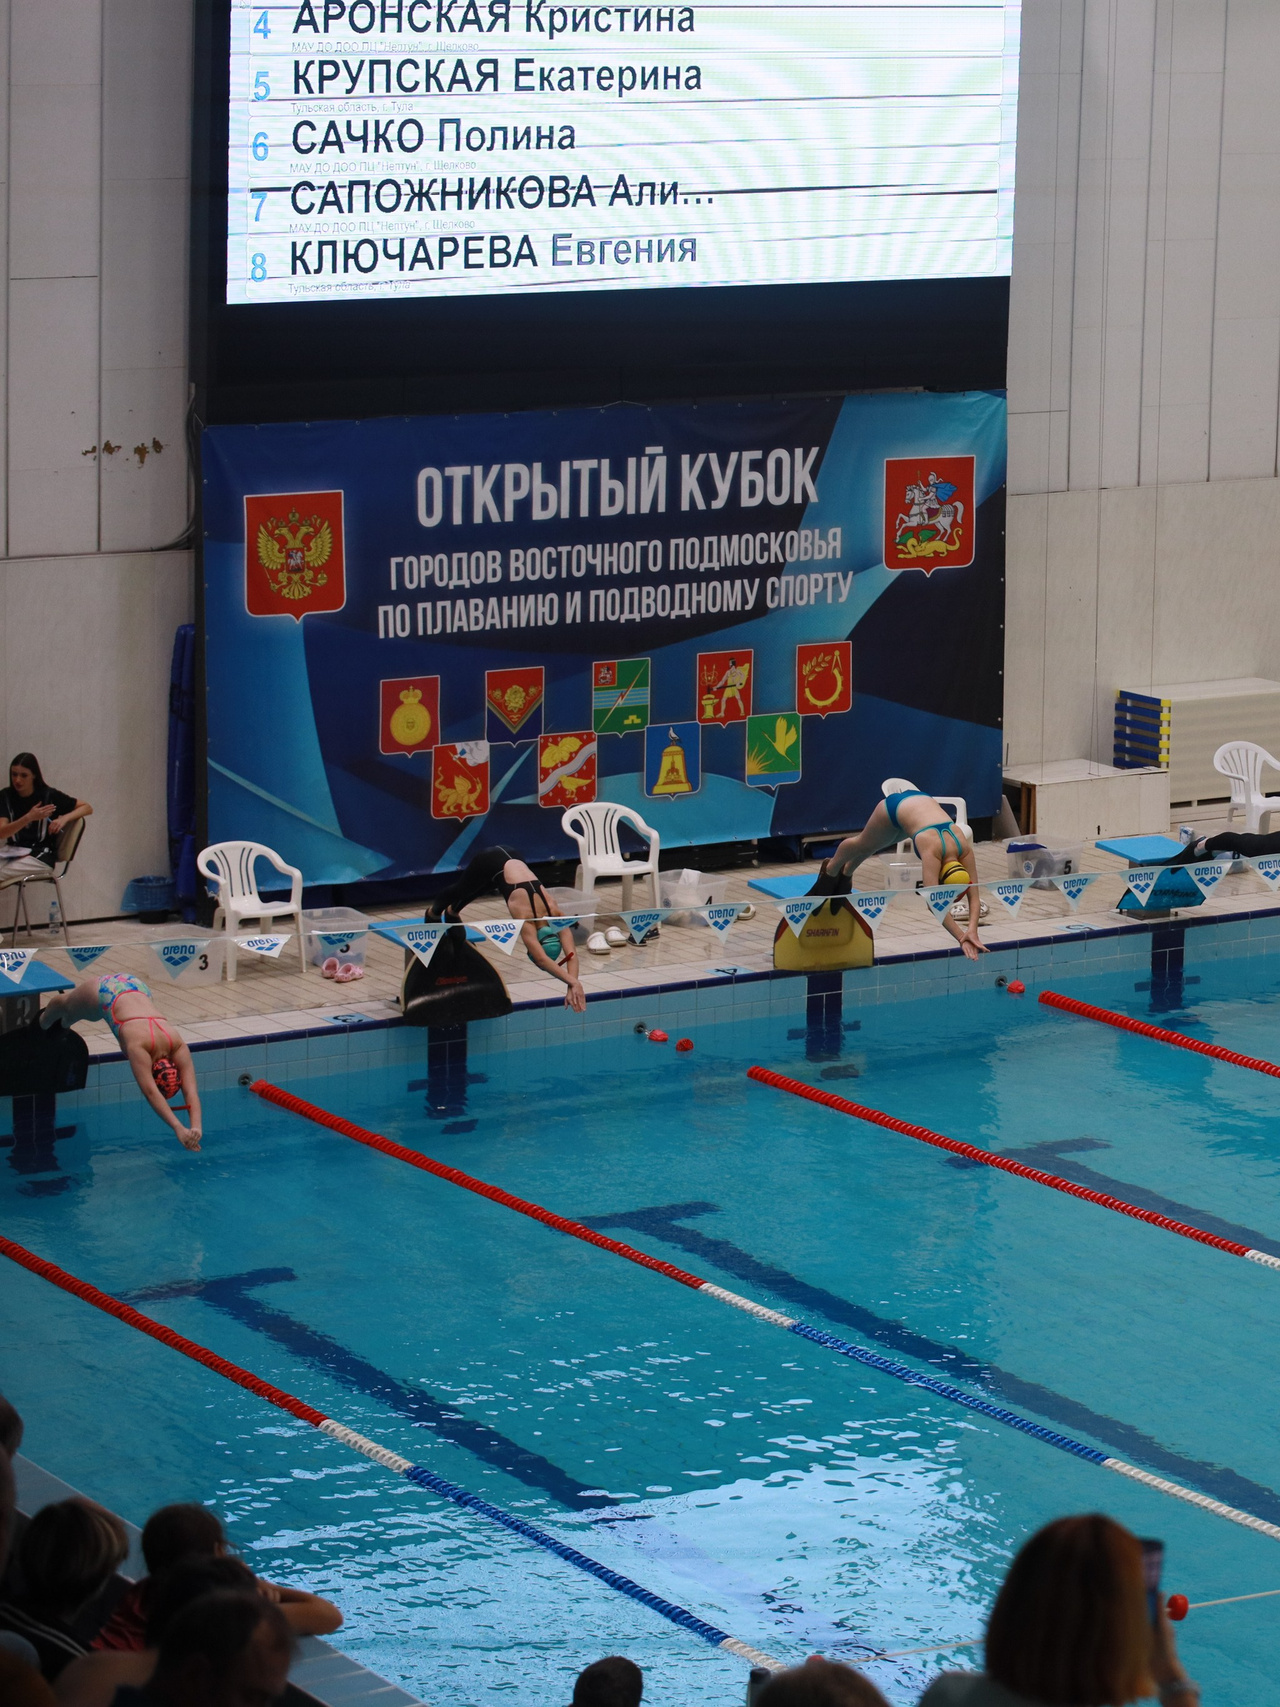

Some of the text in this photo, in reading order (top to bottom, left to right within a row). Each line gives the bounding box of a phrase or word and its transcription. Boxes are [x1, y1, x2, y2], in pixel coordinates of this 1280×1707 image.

[254, 0, 695, 40] 4 АРОНСКАЯ Кристина
[254, 58, 702, 100] 5 КРУПСКАЯ Екатерина
[252, 118, 576, 161] 6 САЧКО Полина
[251, 192, 268, 222] 7
[291, 174, 597, 215] САПОЖНИКОВА
[251, 233, 697, 282] 8 КЛЮЧАРЕВА Евгения
[416, 446, 820, 528] ОТКРЫТЫЙ КУБОК
[390, 527, 842, 591] ГОРОДОВ ВОСТОЧНОГО ПОДМОСКОВЬЯ
[378, 571, 854, 639] ПО ПЛАВАНИЮ И ПОДВОДНОМУ СПОРТУ
[1064, 860, 1072, 874] 5
[1194, 866, 1223, 877] arena
[1128, 871, 1154, 883] arena
[1063, 878, 1089, 889] arena
[930, 890, 955, 902] arena
[998, 884, 1023, 896] arena
[786, 902, 812, 914] arena
[858, 896, 886, 908] arena
[631, 912, 660, 924] arena
[708, 908, 736, 920] arena
[485, 922, 516, 934] arena
[407, 930, 437, 942] arena
[247, 937, 280, 949] arena
[162, 944, 196, 956] arena
[198, 954, 209, 970] 3
